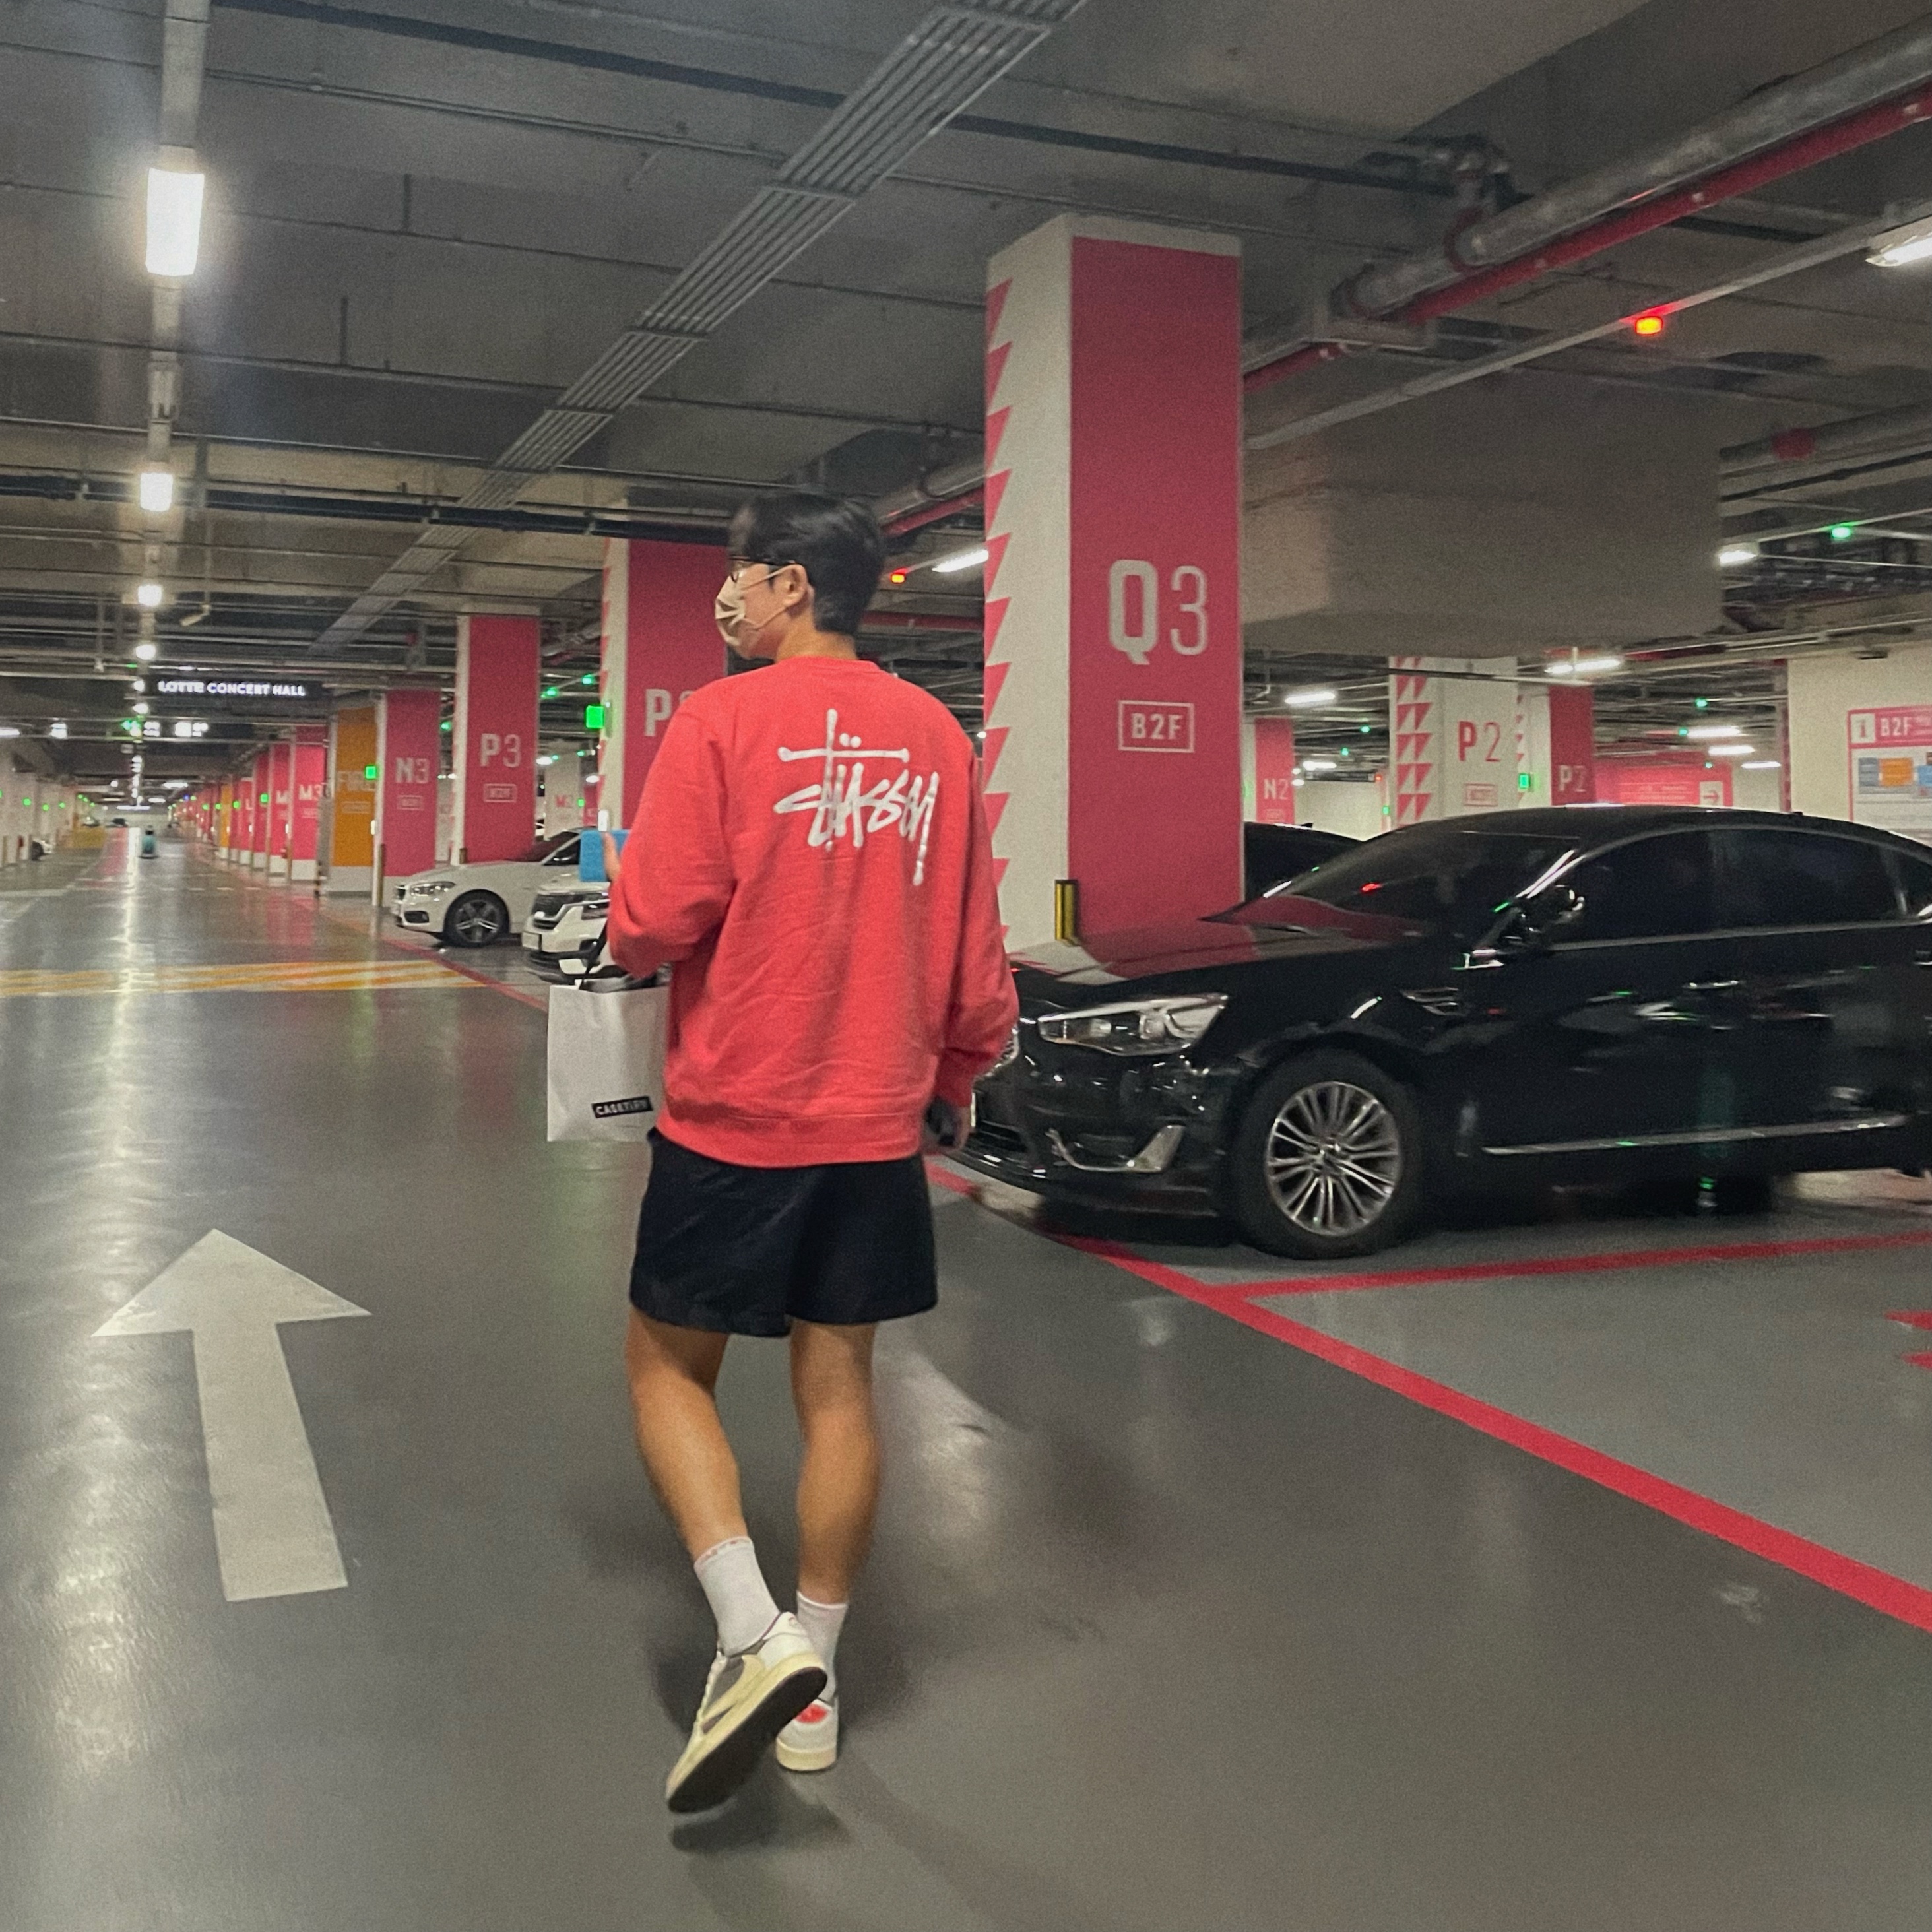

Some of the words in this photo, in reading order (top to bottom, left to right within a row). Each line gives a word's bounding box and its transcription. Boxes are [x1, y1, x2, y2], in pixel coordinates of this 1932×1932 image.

[1109, 559, 1208, 665] Q3
[158, 680, 205, 693] LOTTE
[207, 682, 270, 695] CONCERT
[273, 685, 306, 697] HALL
[1131, 712, 1183, 740] B2F
[1880, 716, 1913, 737] B2F
[480, 733, 521, 767] P3
[1458, 721, 1502, 762] P2
[395, 757, 430, 784] N3
[1264, 778, 1289, 800] N2
